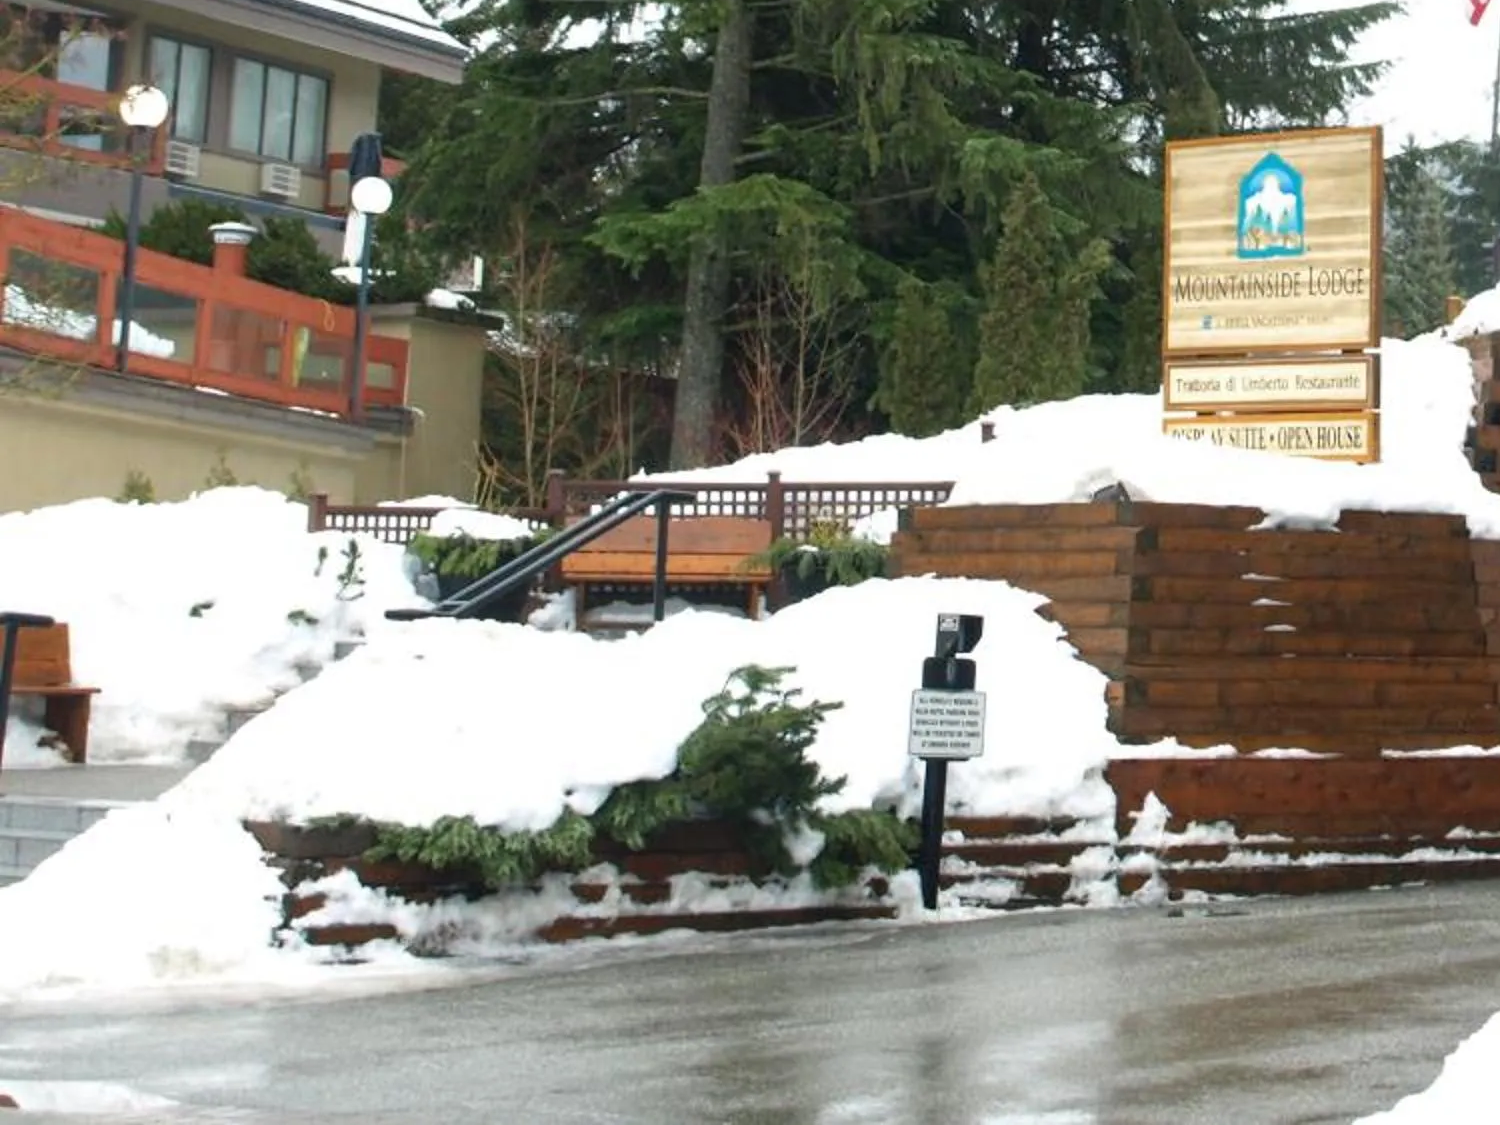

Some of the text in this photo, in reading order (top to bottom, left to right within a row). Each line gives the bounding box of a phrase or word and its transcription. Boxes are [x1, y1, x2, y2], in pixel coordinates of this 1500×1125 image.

[1175, 266, 1365, 303] MOUNTAINSIDE LODGE
[1176, 377, 1221, 393] Trattoria
[1277, 425, 1314, 450] OPEN
[1317, 424, 1363, 450] HOUSE
